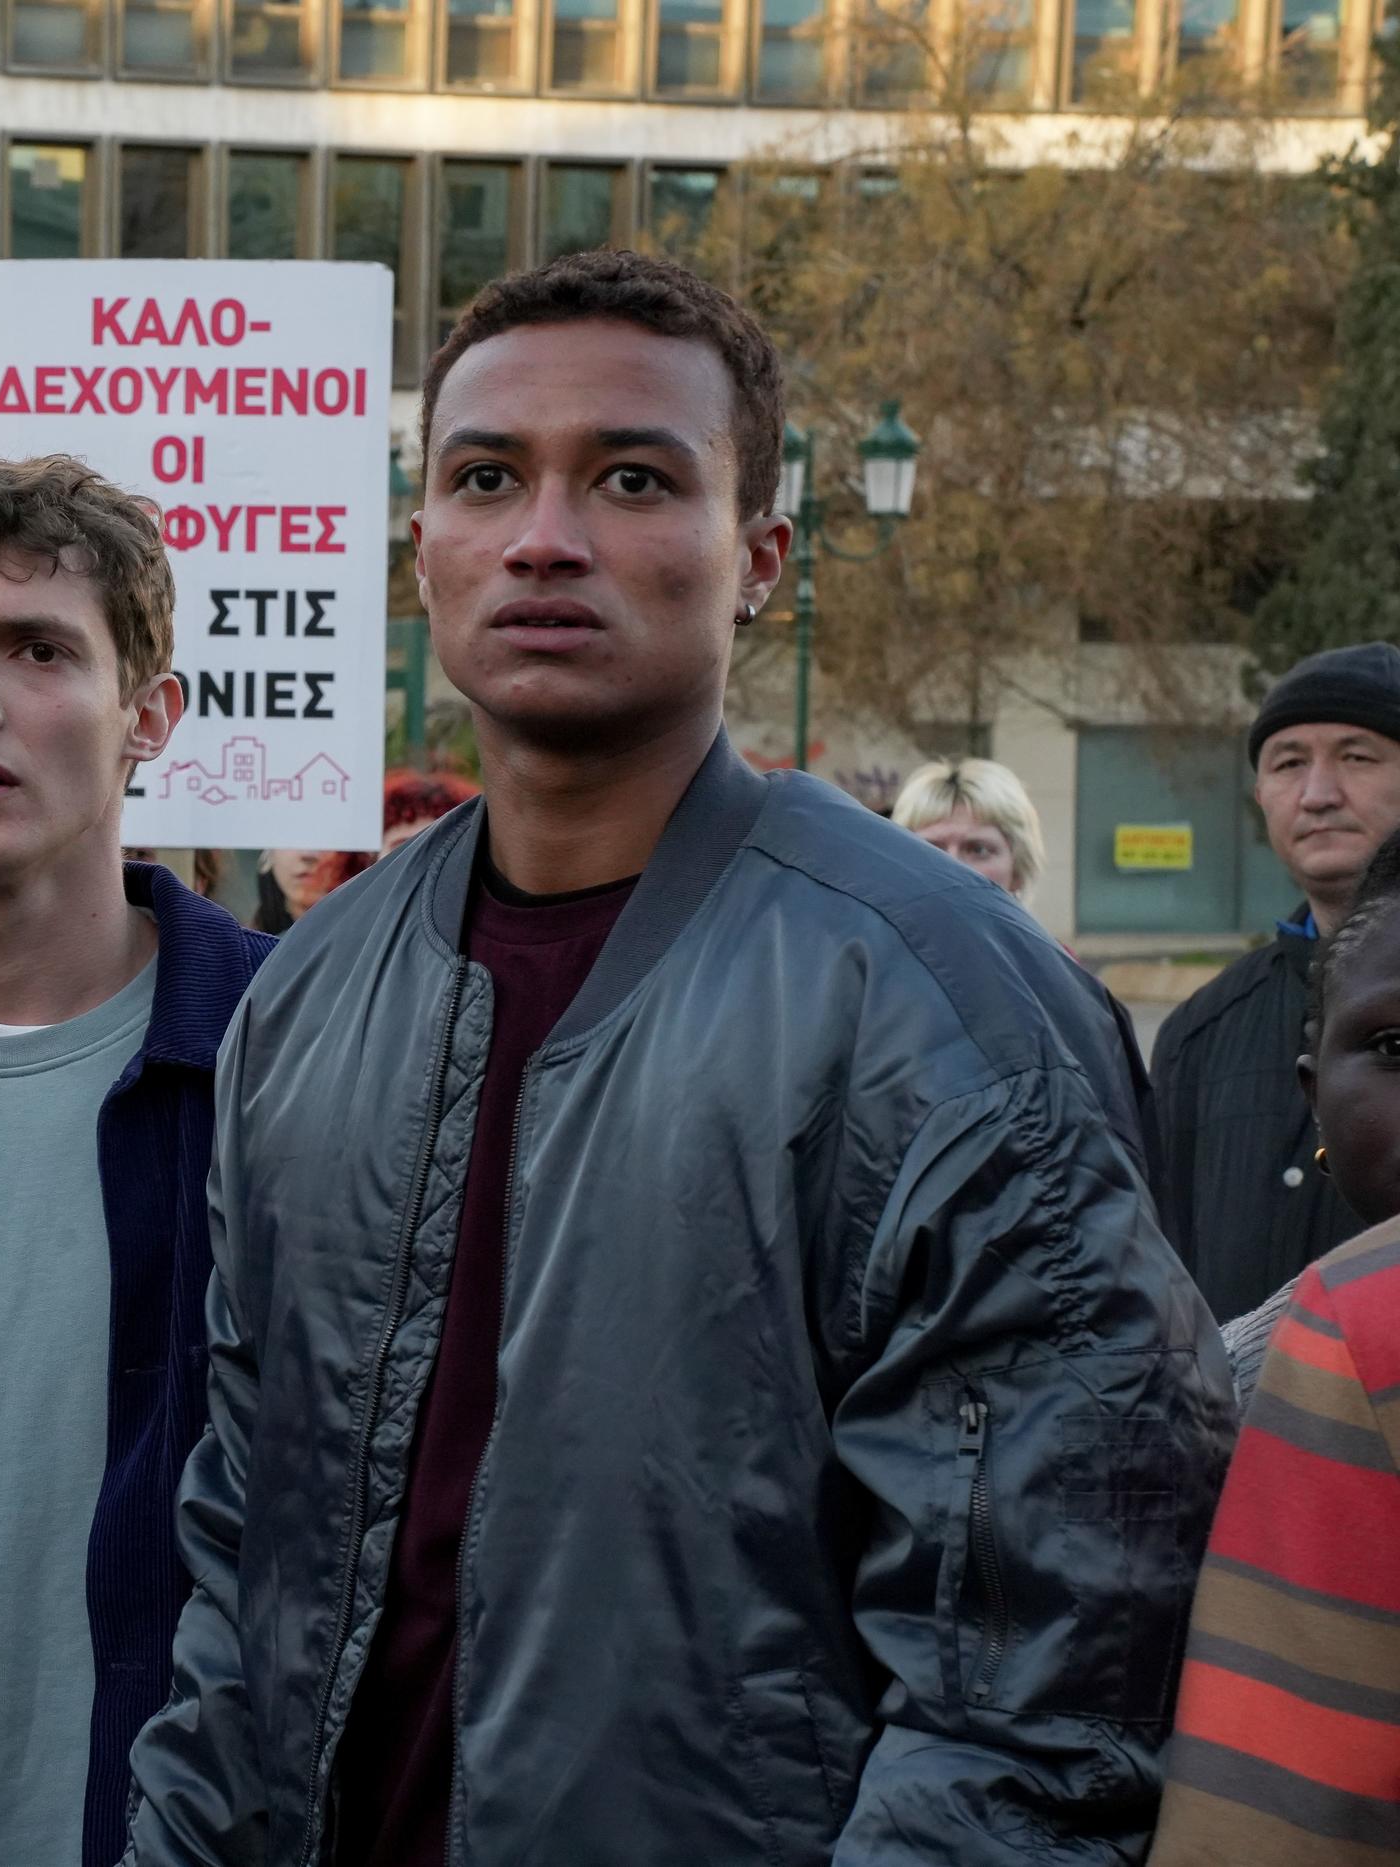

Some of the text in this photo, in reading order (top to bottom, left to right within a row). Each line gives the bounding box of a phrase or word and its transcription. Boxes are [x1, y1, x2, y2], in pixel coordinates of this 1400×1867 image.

[91, 297, 271, 347] ΚΑΛΟ-
[151, 435, 205, 485] ΟΙ
[149, 504, 348, 554] ΦΥΓΕΣ
[206, 588, 337, 639] ΣΤΙΣ
